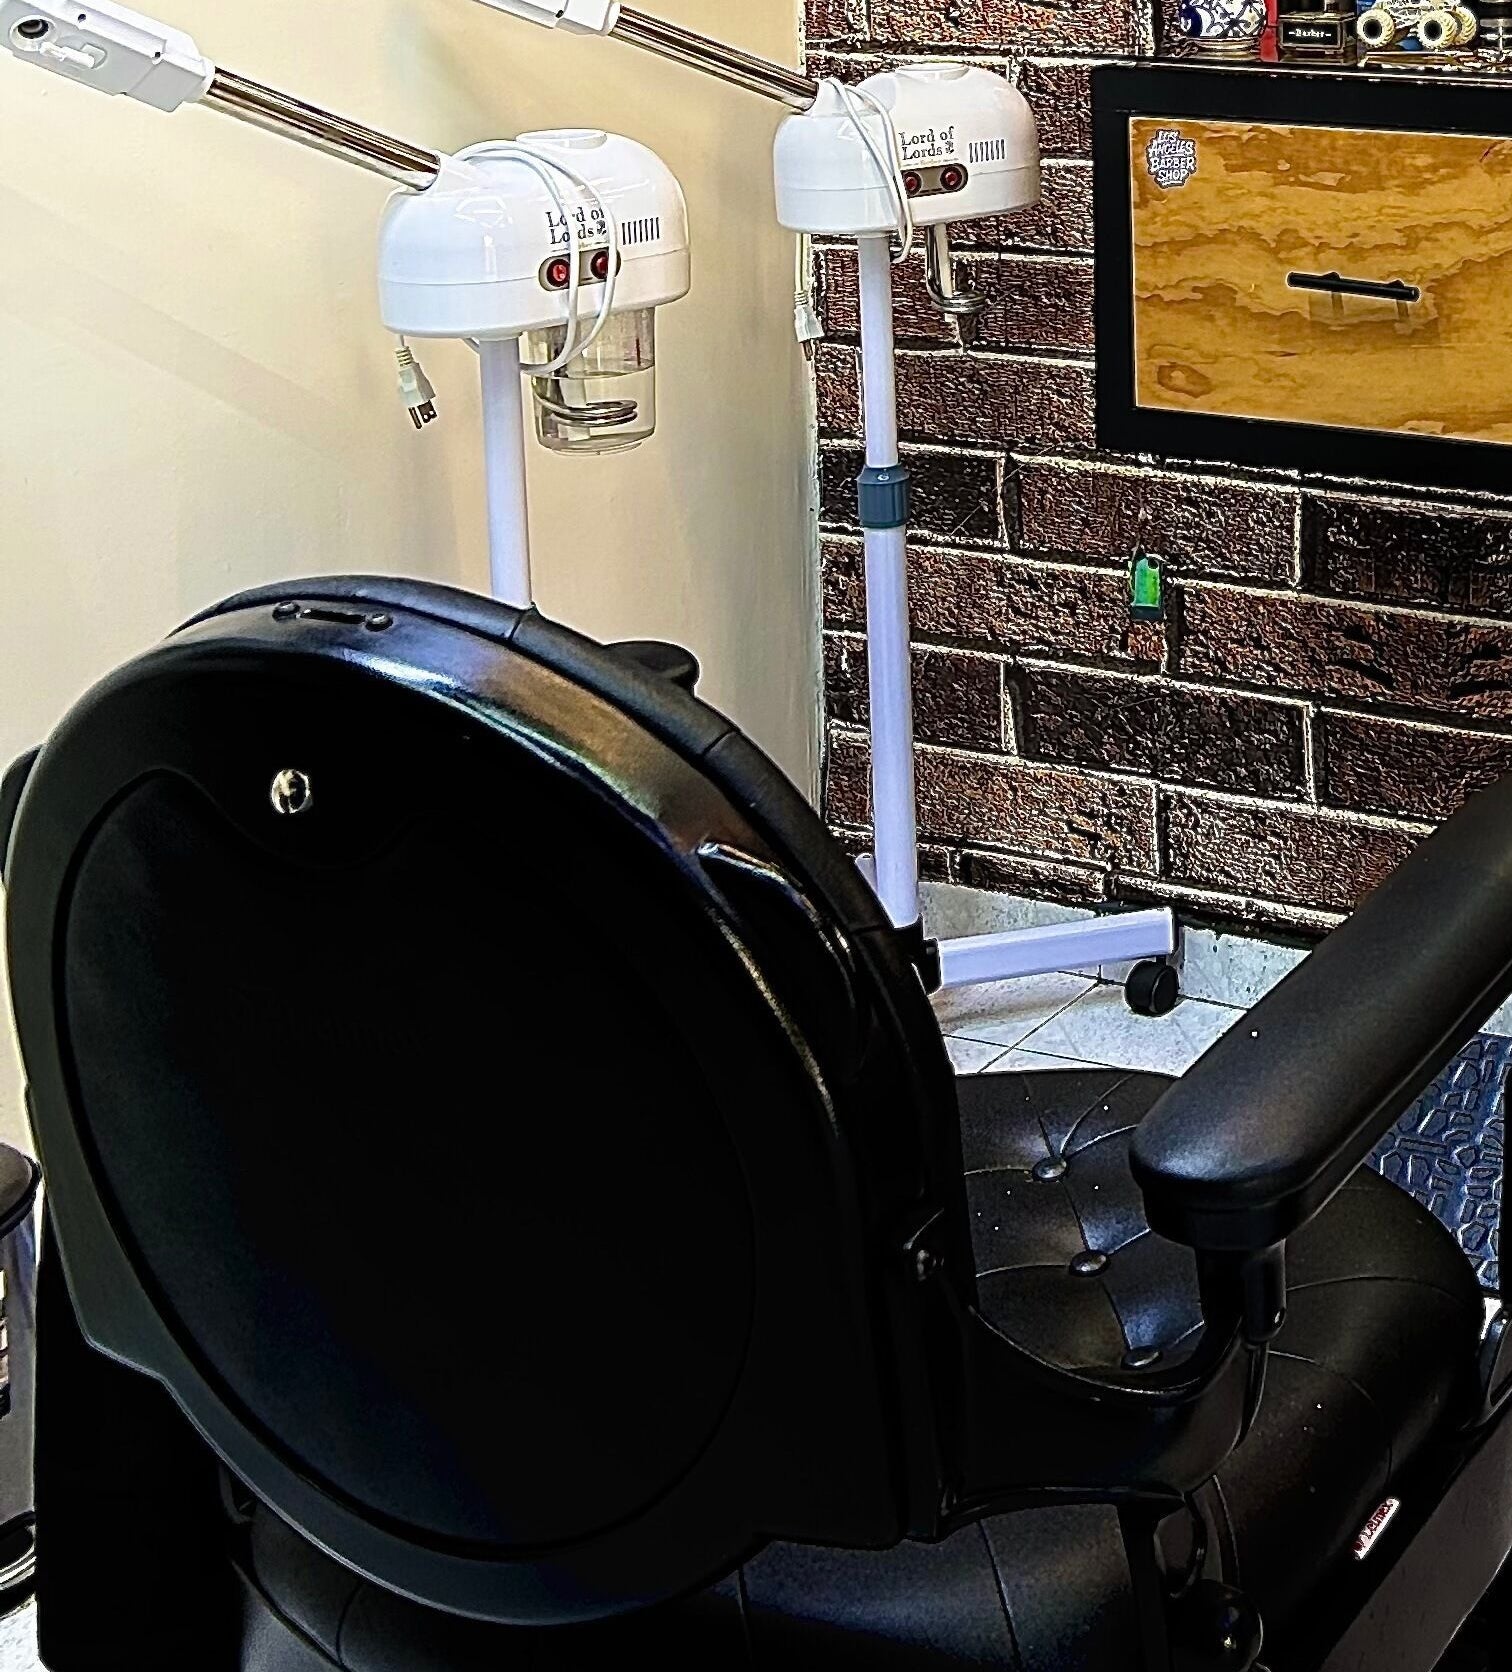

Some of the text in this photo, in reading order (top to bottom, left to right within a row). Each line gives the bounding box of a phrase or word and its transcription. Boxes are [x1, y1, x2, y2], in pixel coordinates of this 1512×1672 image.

[898, 126, 955, 146] Lord of
[902, 143, 943, 160] Lords
[1150, 157, 1195, 172] BARBER
[1157, 168, 1189, 181] SHOP
[545, 206, 586, 227] Lod
[550, 223, 594, 245] Lods
